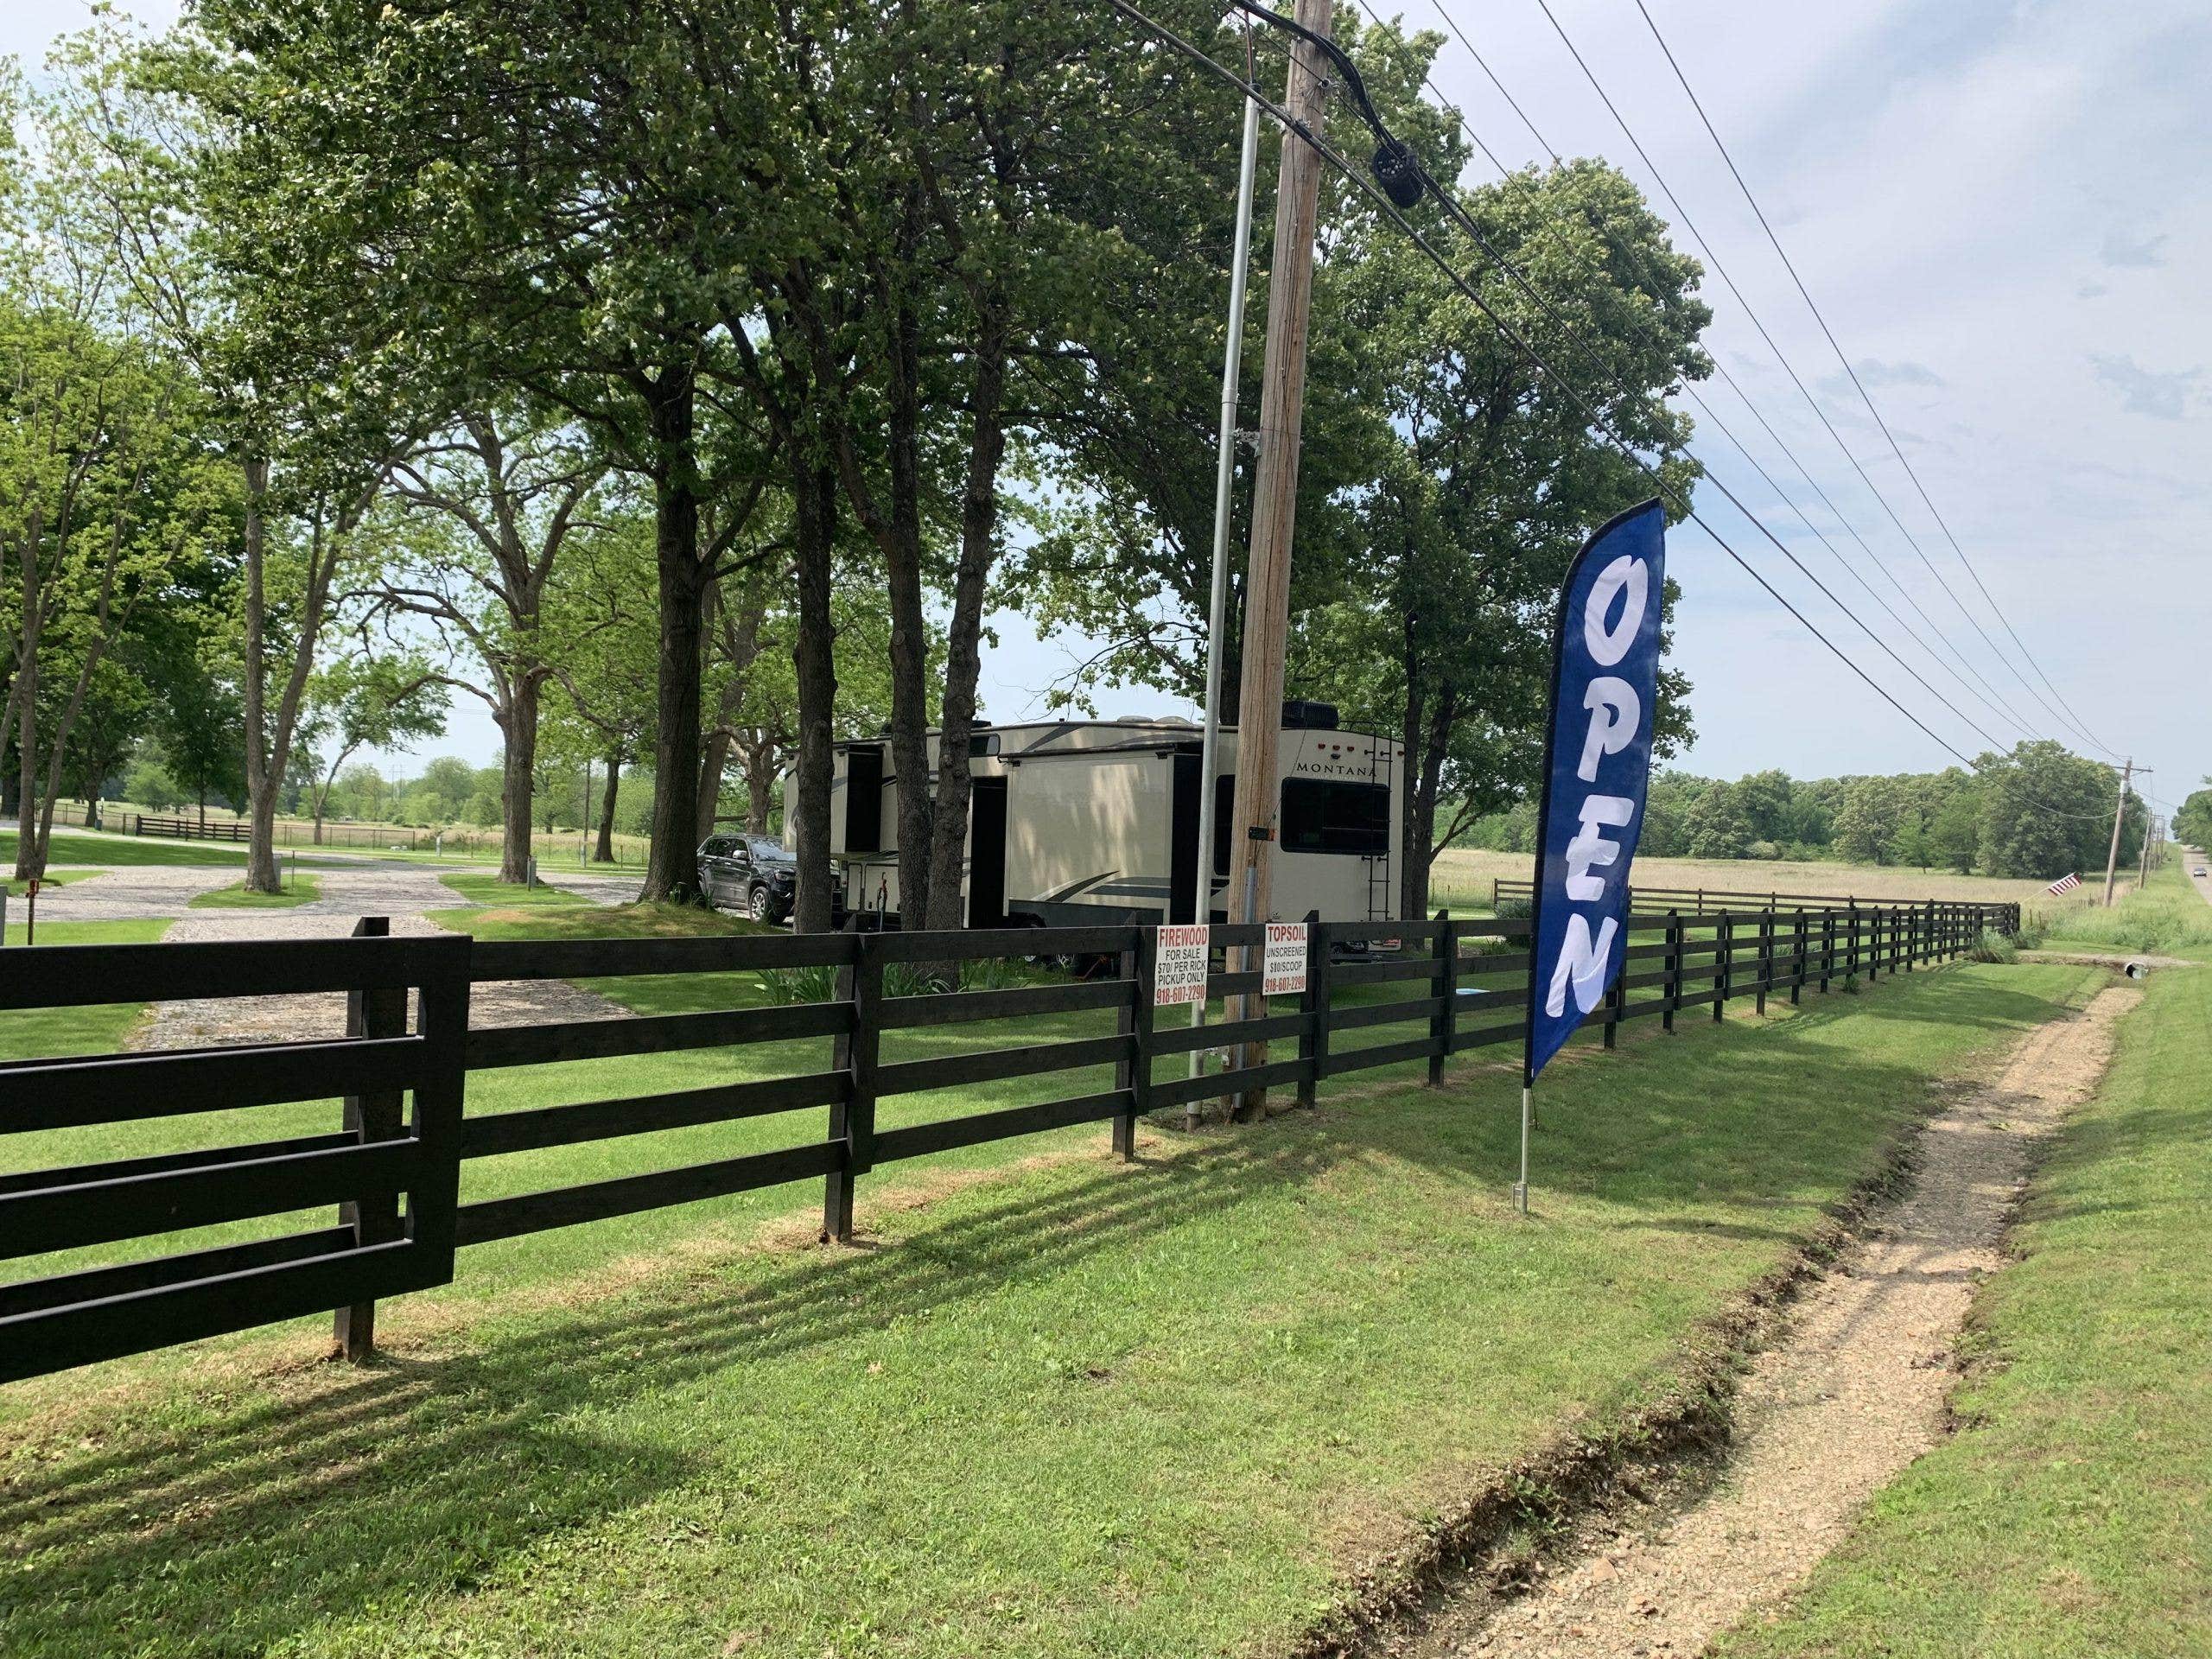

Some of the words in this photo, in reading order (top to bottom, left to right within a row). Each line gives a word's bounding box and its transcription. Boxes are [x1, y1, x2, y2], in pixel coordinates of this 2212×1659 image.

[1296, 762, 1376, 777] MONTANA
[1545, 554, 1648, 1018] OPEN
[1160, 926, 1207, 947] FIREWOOD
[1268, 925, 1306, 942] TOPSOIL
[1166, 949, 1180, 961] FOR
[1182, 948, 1200, 959] SALE
[1266, 945, 1306, 957] UNSCREENED
[1174, 961, 1188, 972] PER
[1190, 959, 1205, 971] RICK
[1158, 973, 1185, 986] PICKUP
[1186, 971, 1205, 982] ONLY
[1265, 975, 1305, 993] 918-607-2290
[1156, 984, 1205, 1004] 918-607-2290
